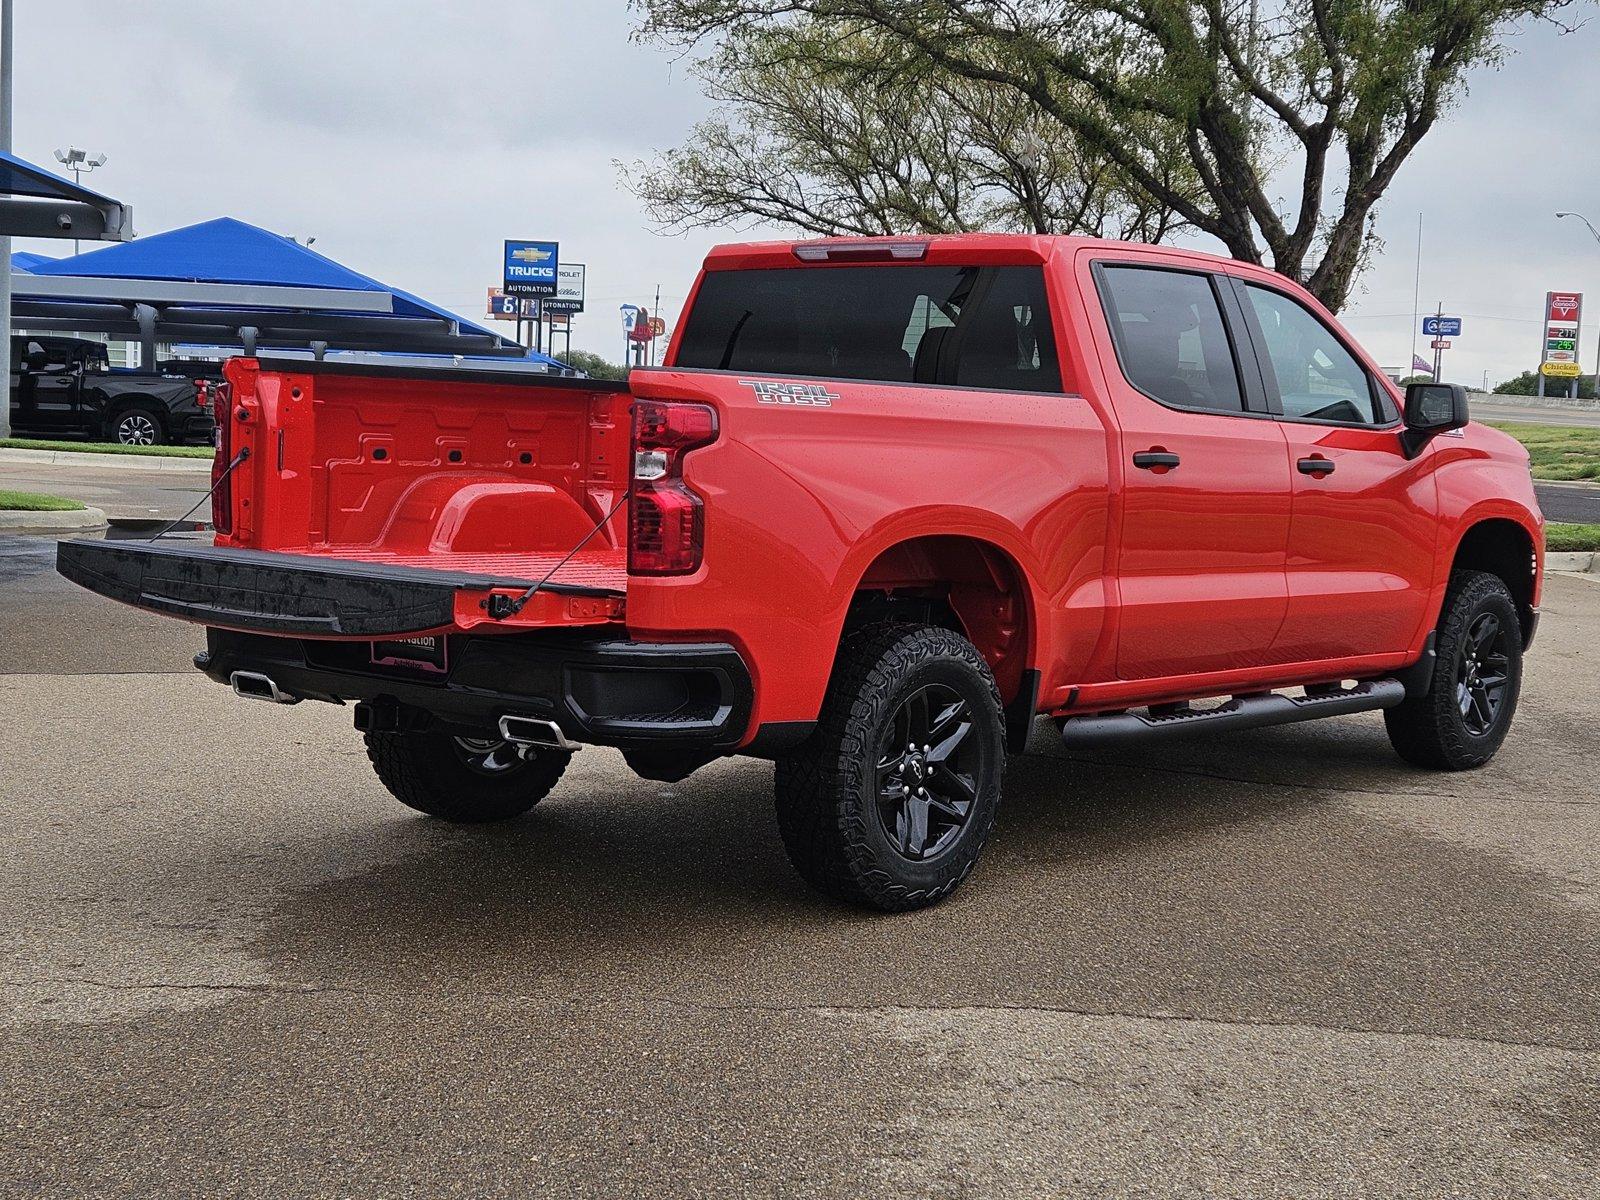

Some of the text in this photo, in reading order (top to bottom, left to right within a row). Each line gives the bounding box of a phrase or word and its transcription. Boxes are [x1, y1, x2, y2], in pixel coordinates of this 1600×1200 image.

[508, 266, 553, 277] TRUCKS
[508, 285, 553, 293] AUTONATION
[1545, 363, 1579, 371] Chicken
[738, 380, 840, 399] TRAIL
[757, 393, 831, 406] BOSS
